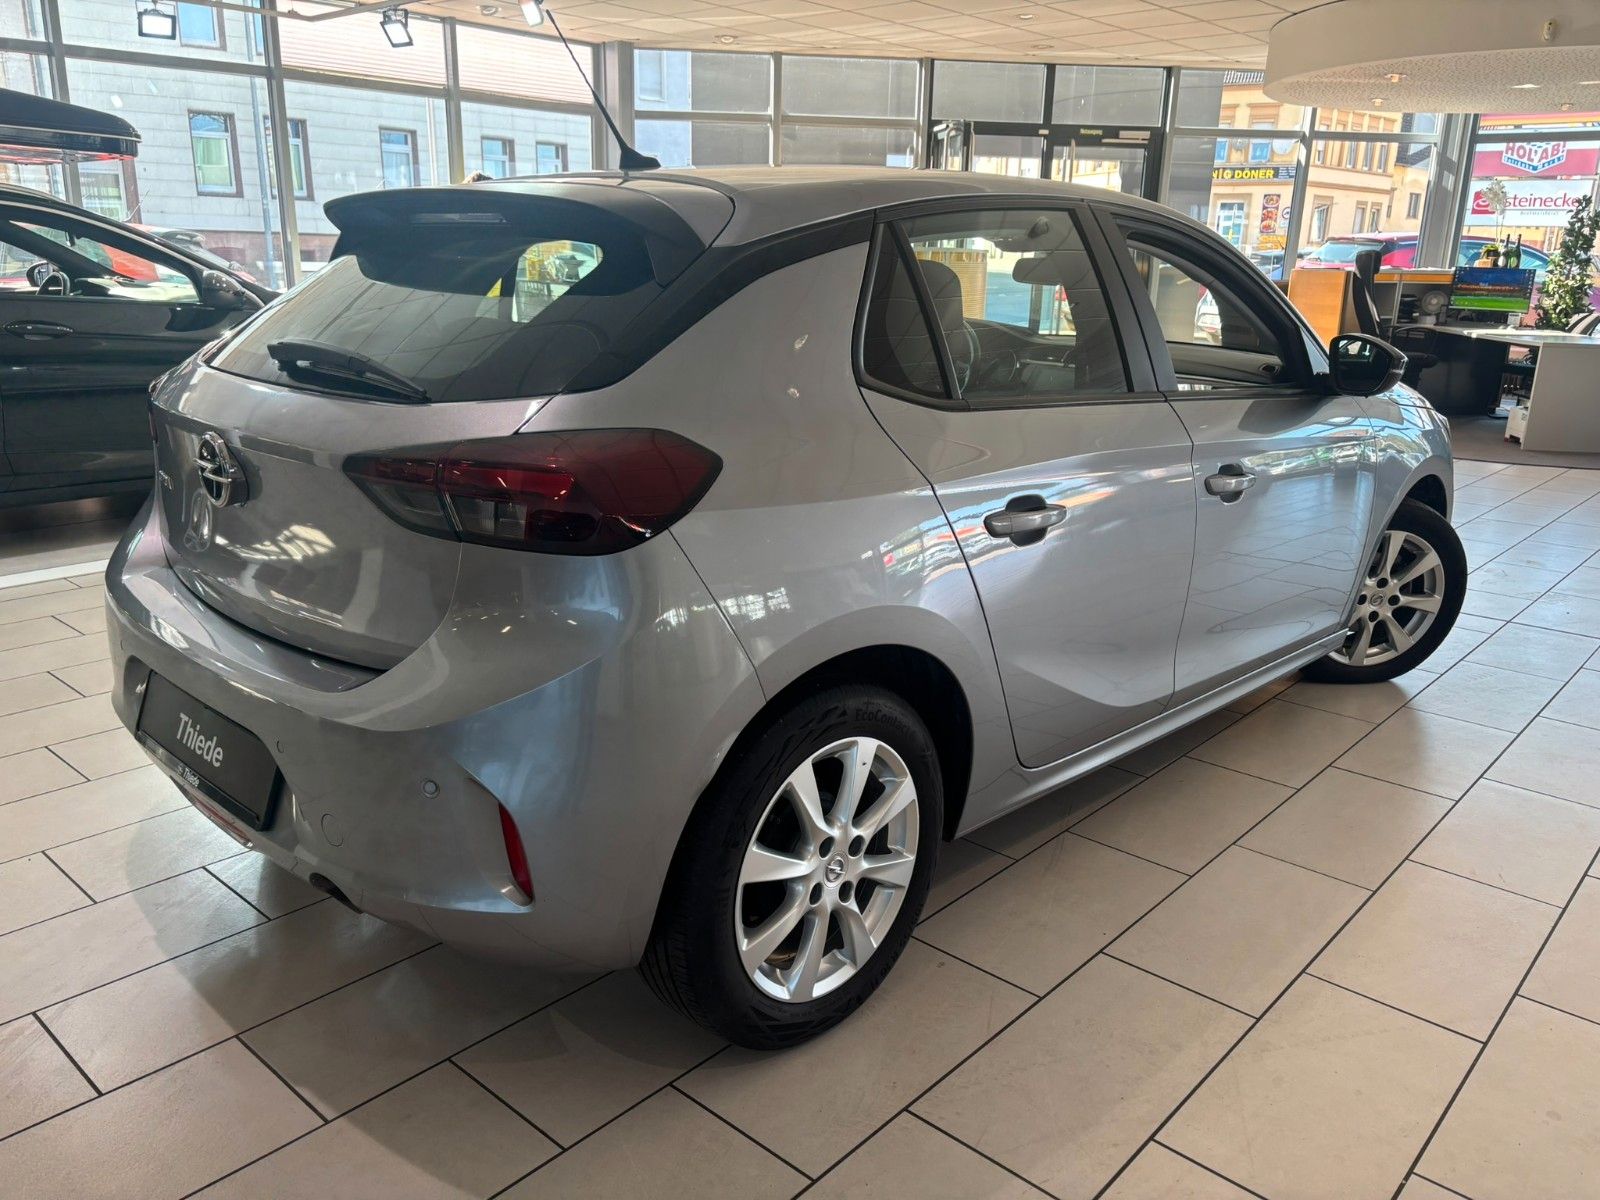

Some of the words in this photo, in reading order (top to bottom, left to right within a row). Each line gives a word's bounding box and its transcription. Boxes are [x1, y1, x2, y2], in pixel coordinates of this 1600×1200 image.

[1234, 167, 1275, 179] DÖNER
[1504, 192, 1581, 208] steinecke
[177, 712, 223, 768] Thiede
